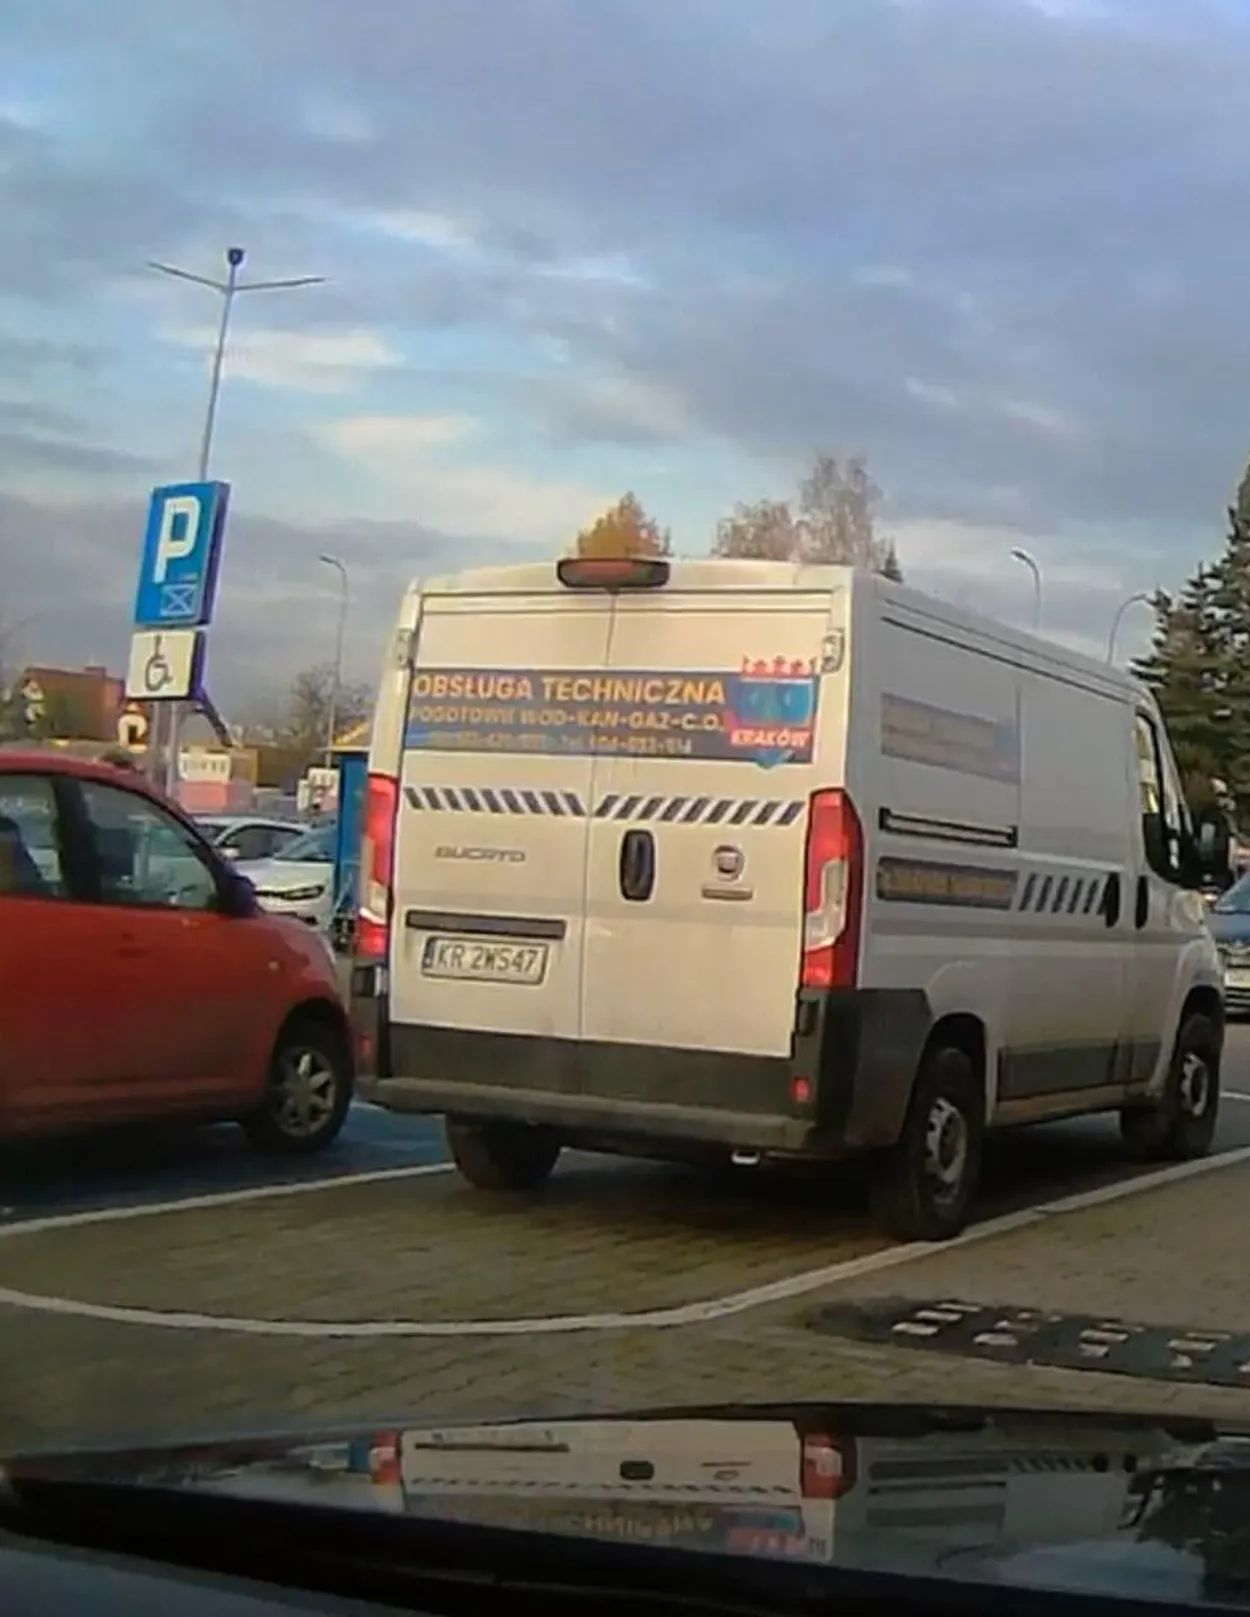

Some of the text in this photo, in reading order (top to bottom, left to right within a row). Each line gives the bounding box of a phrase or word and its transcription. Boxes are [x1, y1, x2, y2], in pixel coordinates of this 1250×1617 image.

[153, 495, 200, 584] P
[413, 675, 726, 706] OBSŁUGA TECHNICZNA
[730, 725, 811, 749] KRAKÓW
[434, 846, 526, 862] DUCATO
[436, 942, 463, 969] KR
